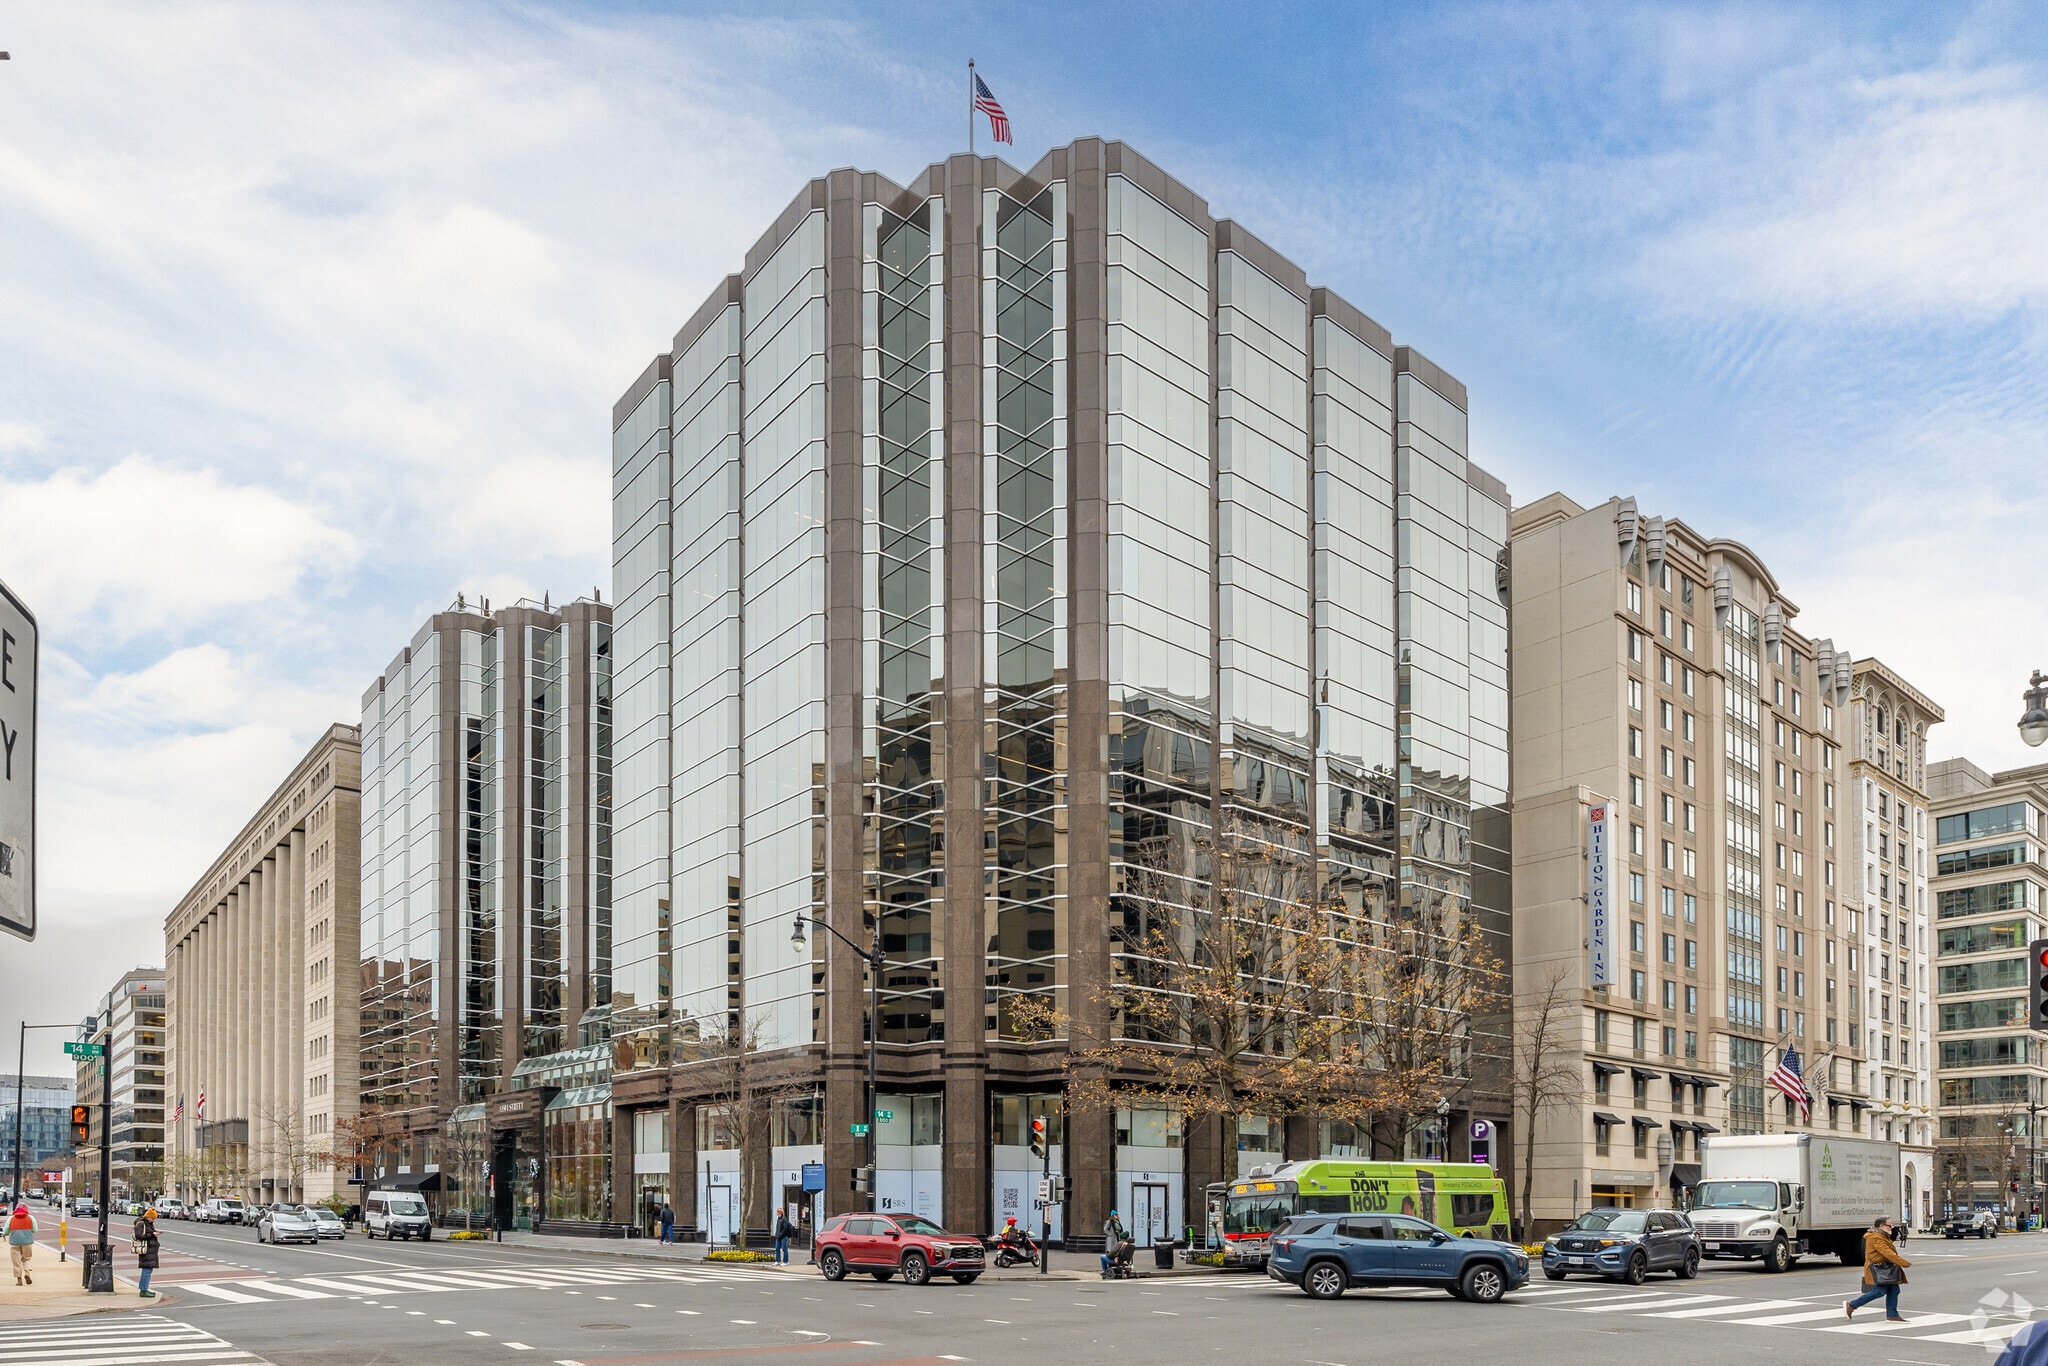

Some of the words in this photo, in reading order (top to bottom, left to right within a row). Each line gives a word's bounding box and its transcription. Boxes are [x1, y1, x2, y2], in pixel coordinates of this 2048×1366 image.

[1593, 825, 1603, 884] HILTON
[1594, 888, 1604, 947] GARDEN
[1594, 953, 1604, 982] INN
[71, 1044, 83, 1053] 14
[72, 1054, 94, 1062] 900
[80, 1127, 86, 1139] 4
[1475, 1123, 1486, 1136] P
[1819, 1171, 1836, 1181] GERSTEL
[1350, 1179, 1389, 1195] DON'T
[1353, 1195, 1387, 1211] HOLD
